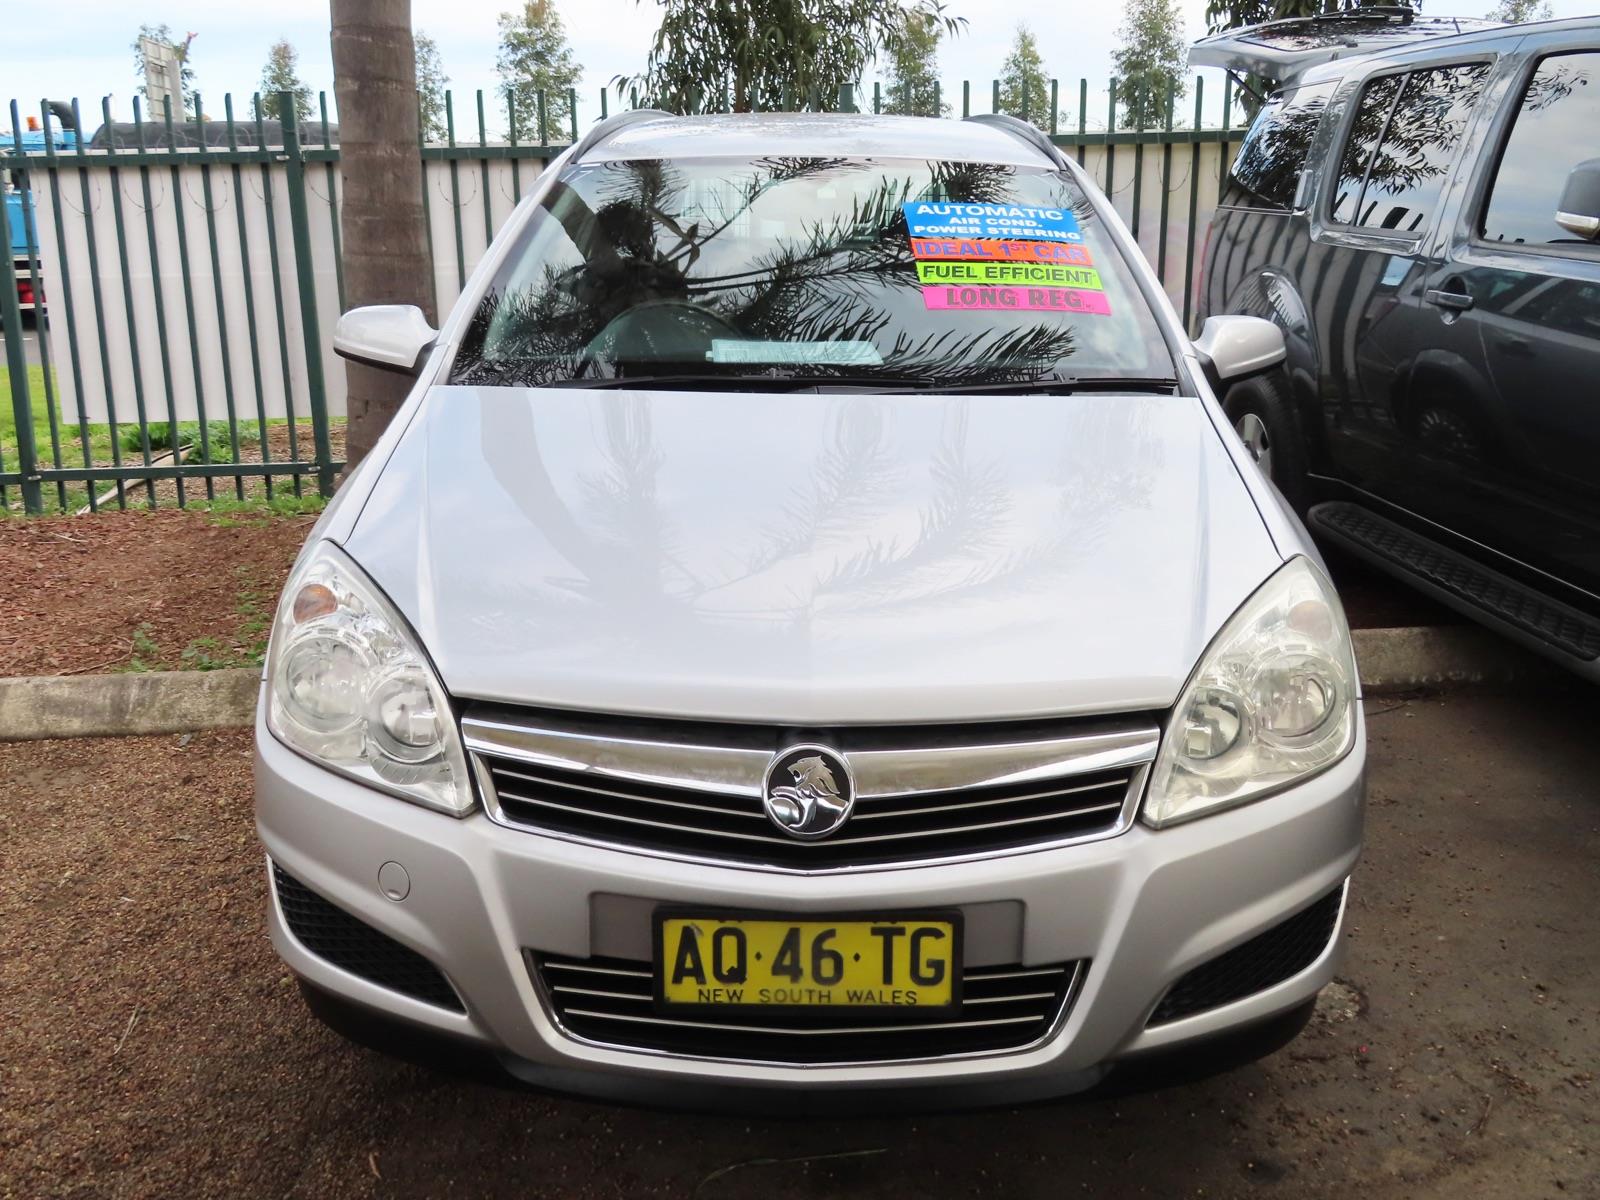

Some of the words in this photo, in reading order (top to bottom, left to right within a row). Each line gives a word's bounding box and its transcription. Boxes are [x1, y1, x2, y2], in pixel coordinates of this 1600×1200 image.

[916, 204, 1064, 221] AUTOMATIC
[949, 217, 982, 225] AIR
[985, 217, 1043, 228] COND.
[913, 225, 983, 235] POWER
[986, 226, 1081, 240] STEERING
[915, 242, 993, 257] IDEAL
[1033, 244, 1087, 262] CAR
[923, 265, 978, 279] FUEL
[984, 266, 1093, 284] EFFICIENT
[946, 287, 1017, 306] LONG
[697, 988, 744, 1003] NEW
[758, 989, 831, 1005] SOUTH
[845, 990, 918, 1006] WALES
